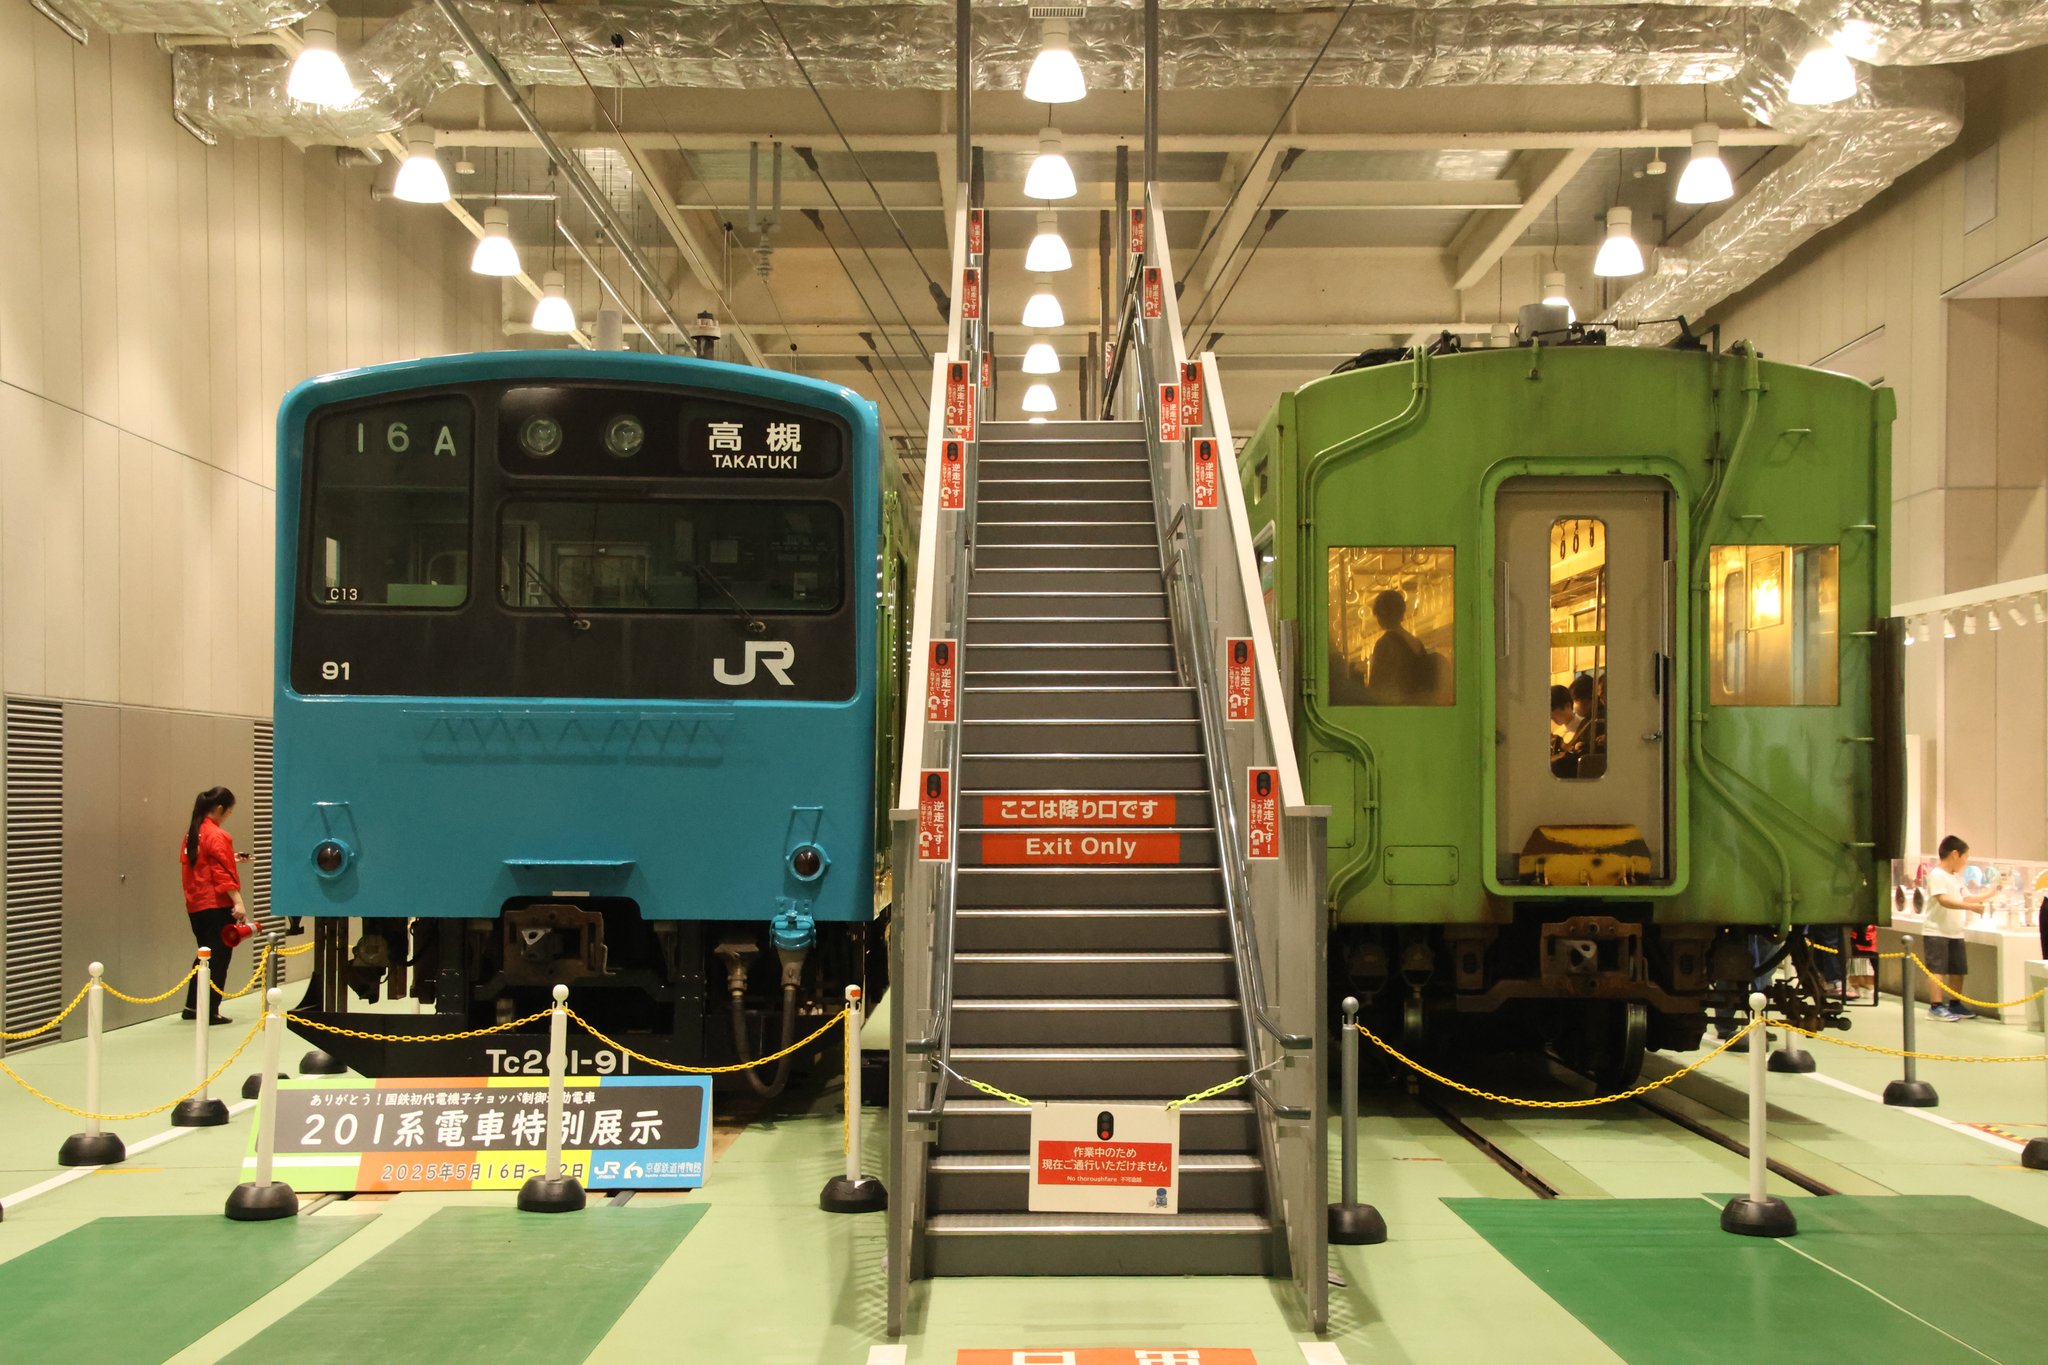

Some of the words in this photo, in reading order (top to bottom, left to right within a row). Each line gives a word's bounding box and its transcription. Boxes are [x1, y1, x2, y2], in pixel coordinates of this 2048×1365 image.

[708, 421, 802, 452] 高槻
[712, 454, 797, 470] TAKATUKI
[330, 588, 358, 601] C13
[322, 661, 350, 681] 91
[713, 640, 795, 686] JR
[1001, 798, 1159, 820] ここは降り口です
[933, 800, 945, 856] 逆走です！
[1263, 798, 1274, 854] 逆走です！
[1026, 837, 1072, 855] Exit
[1081, 837, 1137, 859] Only
[1073, 1146, 1137, 1158] 作業中のため
[1042, 1158, 1168, 1173] 現在ご通行いただけません
